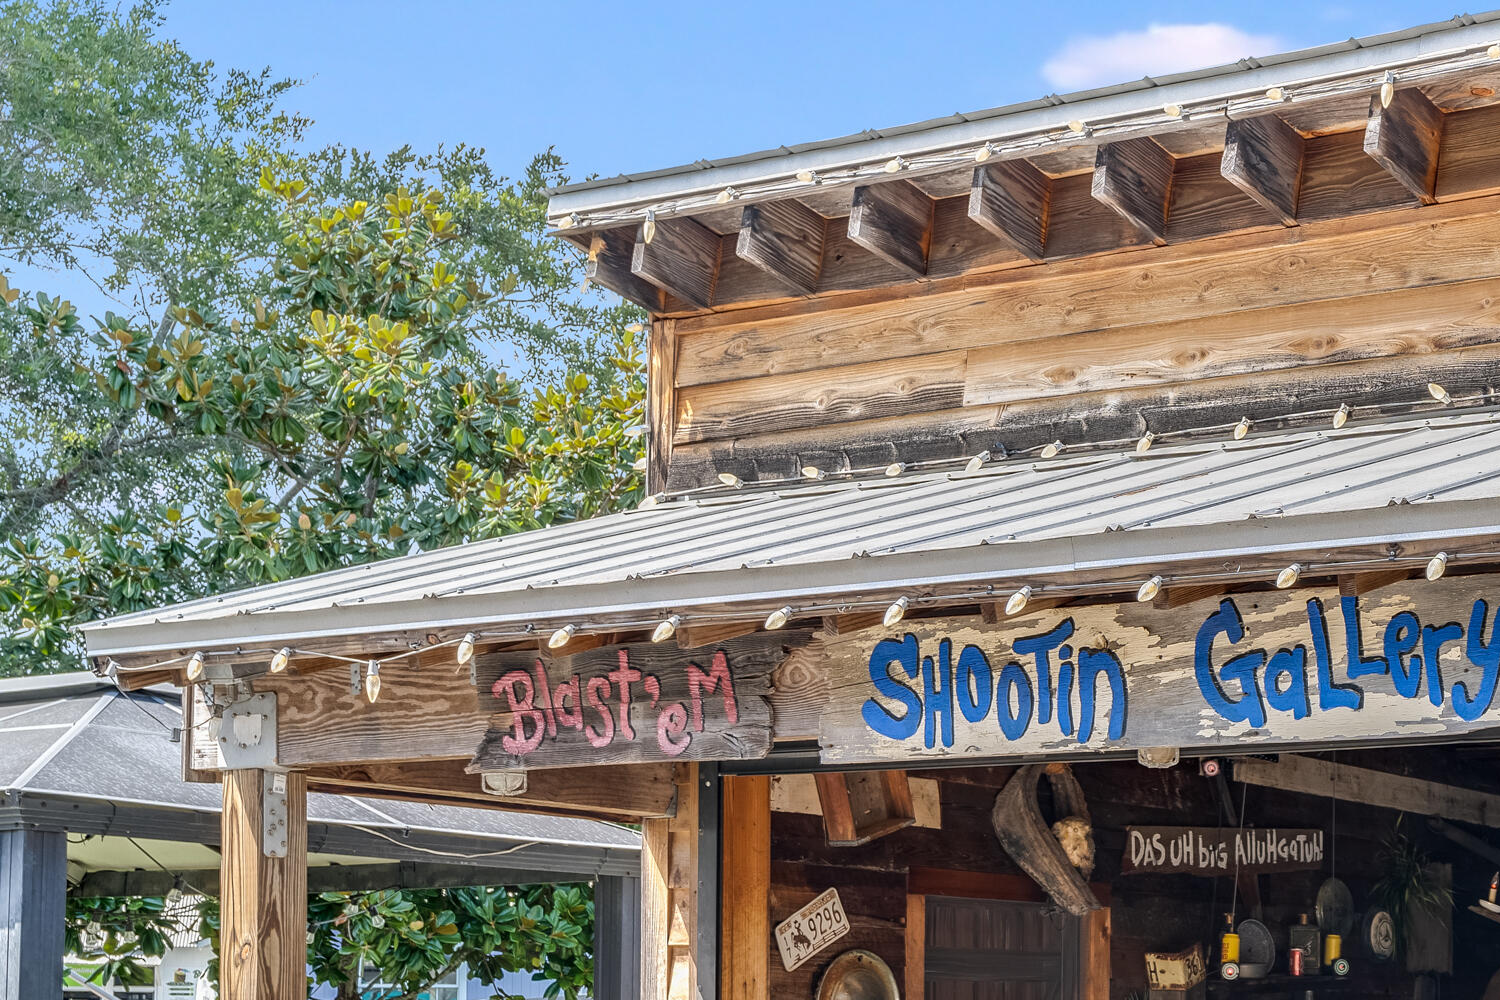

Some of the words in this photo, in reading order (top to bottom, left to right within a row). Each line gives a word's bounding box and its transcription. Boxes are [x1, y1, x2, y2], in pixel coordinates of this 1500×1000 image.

[1131, 830, 1165, 867] DAS
[1170, 830, 1194, 866] UH
[807, 902, 842, 940] 9296
